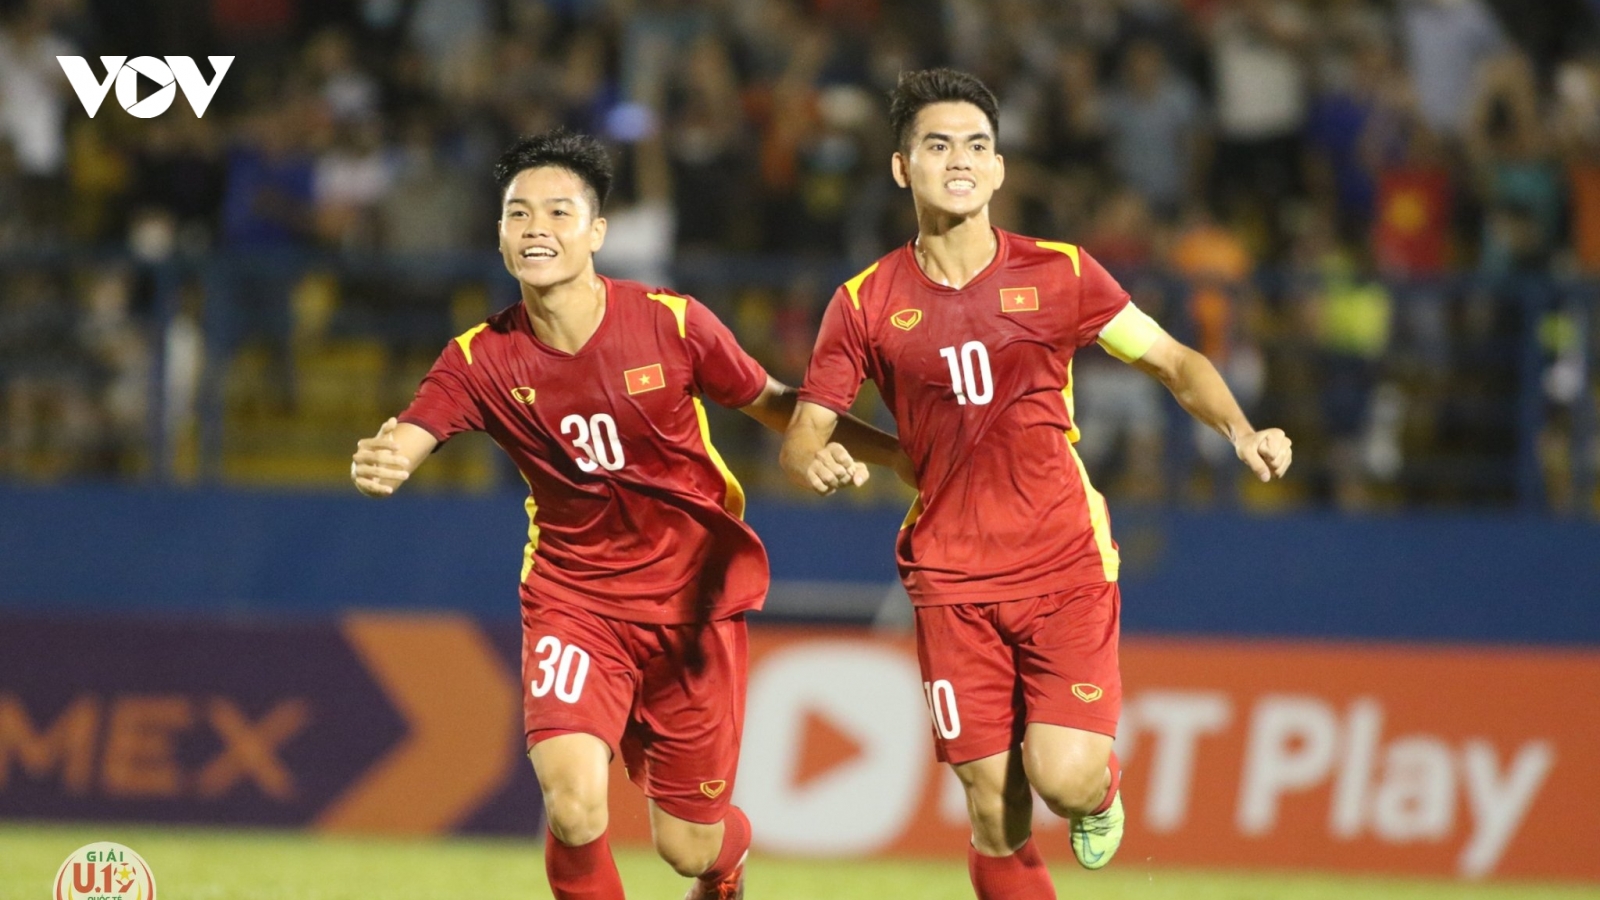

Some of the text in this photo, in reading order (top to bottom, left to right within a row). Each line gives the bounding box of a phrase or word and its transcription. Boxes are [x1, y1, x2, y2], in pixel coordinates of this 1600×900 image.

[940, 341, 994, 405] 10
[560, 413, 625, 472] 30
[530, 636, 590, 704] 30
[0, 696, 308, 795] MEX
[1235, 697, 1554, 878] Play
